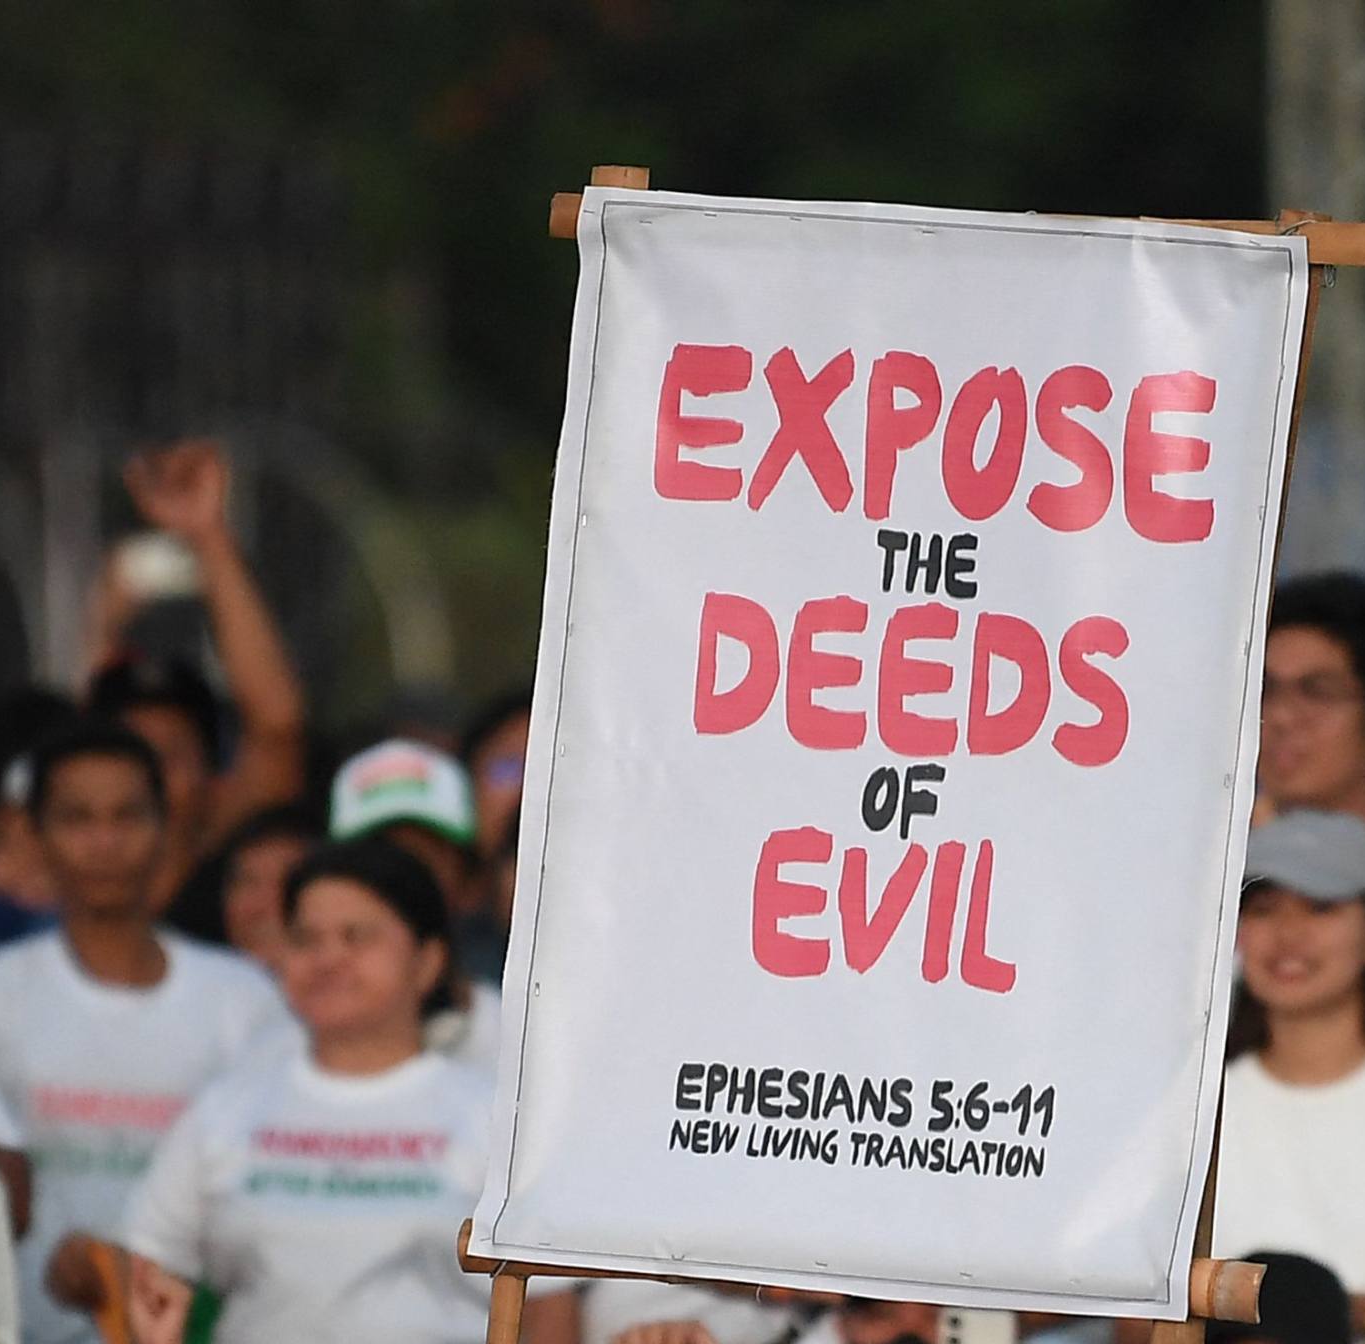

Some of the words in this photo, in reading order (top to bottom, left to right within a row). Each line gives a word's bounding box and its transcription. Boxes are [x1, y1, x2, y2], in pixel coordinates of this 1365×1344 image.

[653, 342, 1218, 545] EXPOSE
[876, 529, 979, 600] THE
[693, 591, 1132, 769] DEEDS
[860, 763, 947, 841] OF
[751, 824, 1018, 994] EVIL
[674, 1062, 914, 1129] EPHESIANS
[927, 1079, 1056, 1139] 5:6-11
[668, 1117, 741, 1156] NEW
[745, 1122, 840, 1167] LIVING
[850, 1131, 1046, 1179] TRANSLATION
